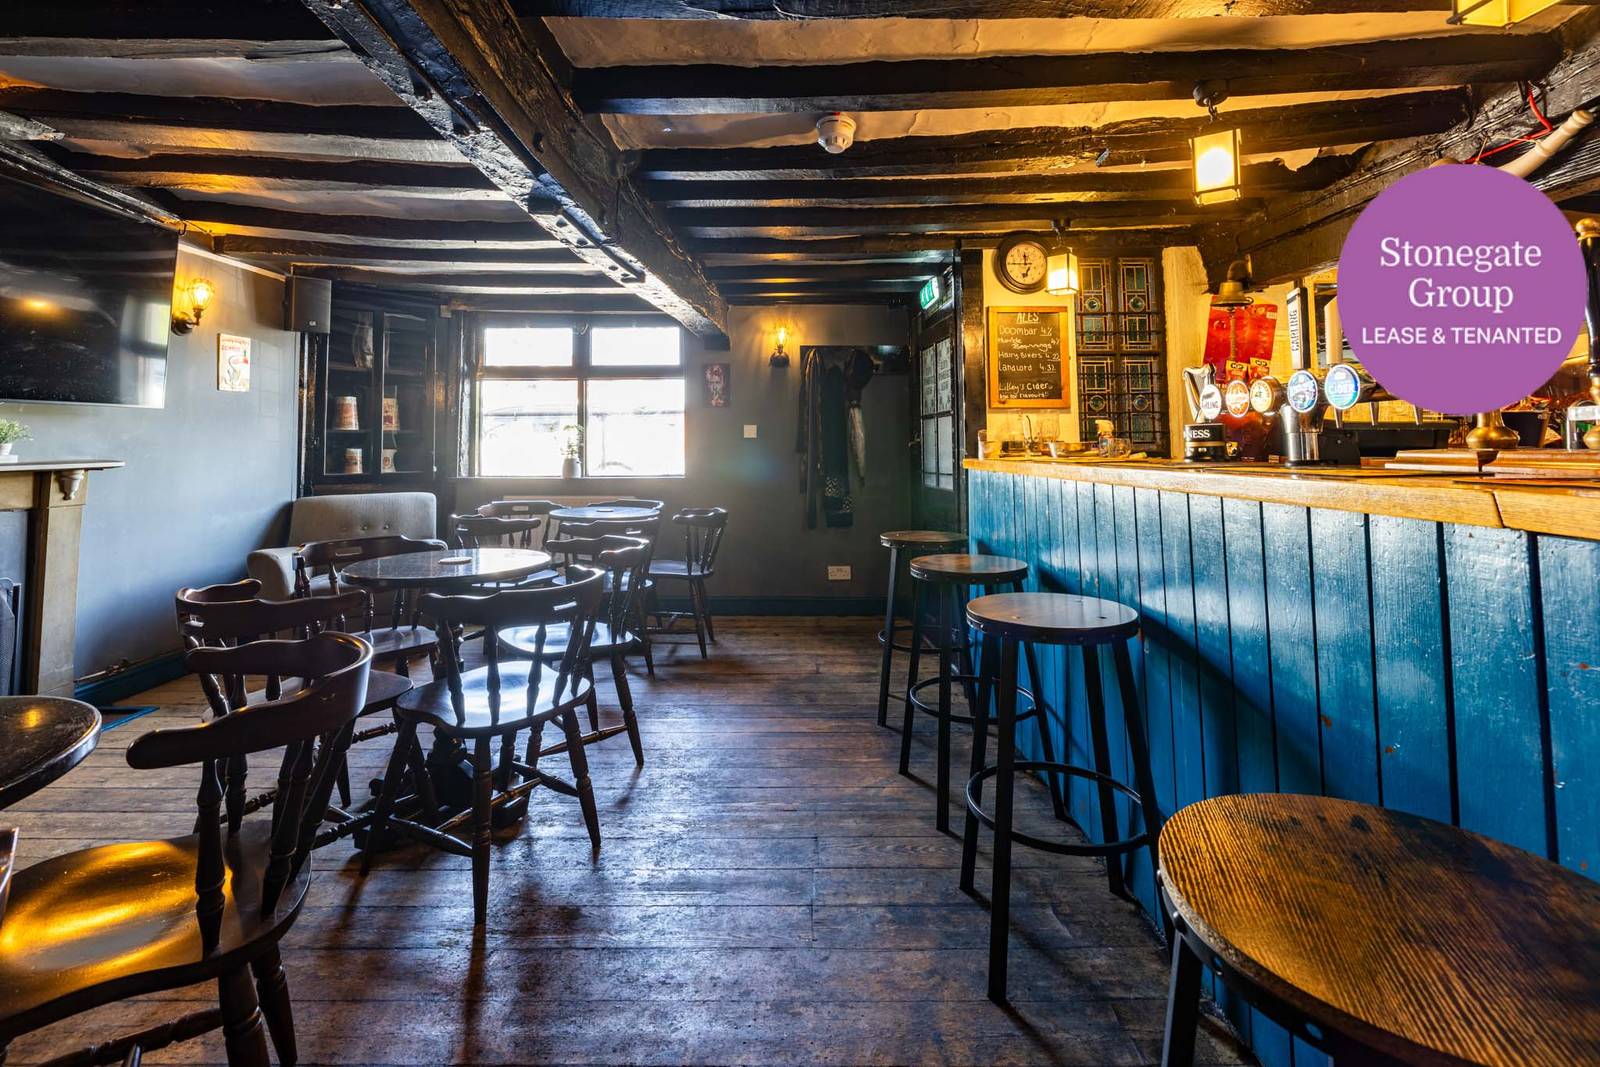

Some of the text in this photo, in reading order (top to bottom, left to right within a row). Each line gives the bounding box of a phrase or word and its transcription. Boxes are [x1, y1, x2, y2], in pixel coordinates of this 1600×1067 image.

[1017, 312, 1040, 323] ALES
[999, 325, 1037, 336] Doombar
[1290, 309, 1300, 352] CARLING
